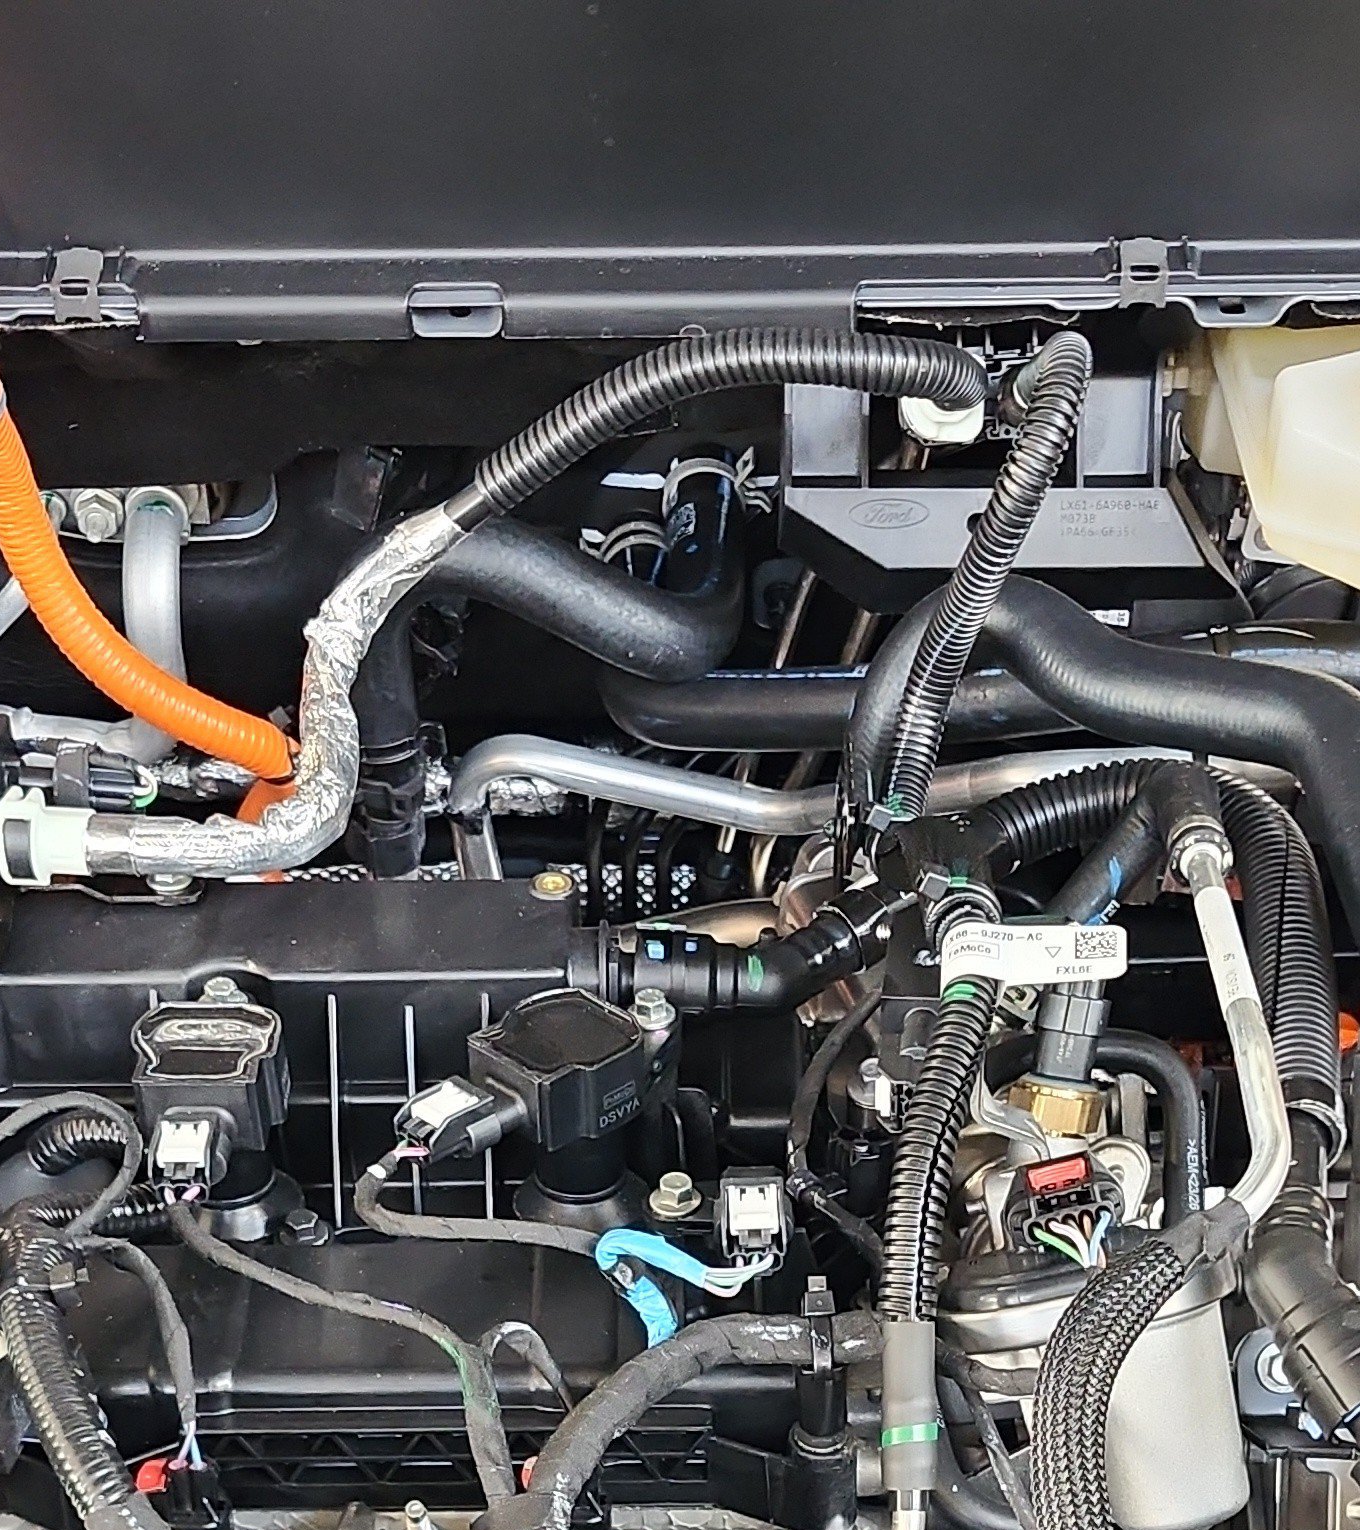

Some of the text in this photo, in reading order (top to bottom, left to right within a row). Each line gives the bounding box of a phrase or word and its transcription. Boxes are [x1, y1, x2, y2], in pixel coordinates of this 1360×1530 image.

[862, 501, 915, 526] Ford
[948, 944, 991, 960] FoMoCo
[599, 1097, 641, 1128] DSVYA
